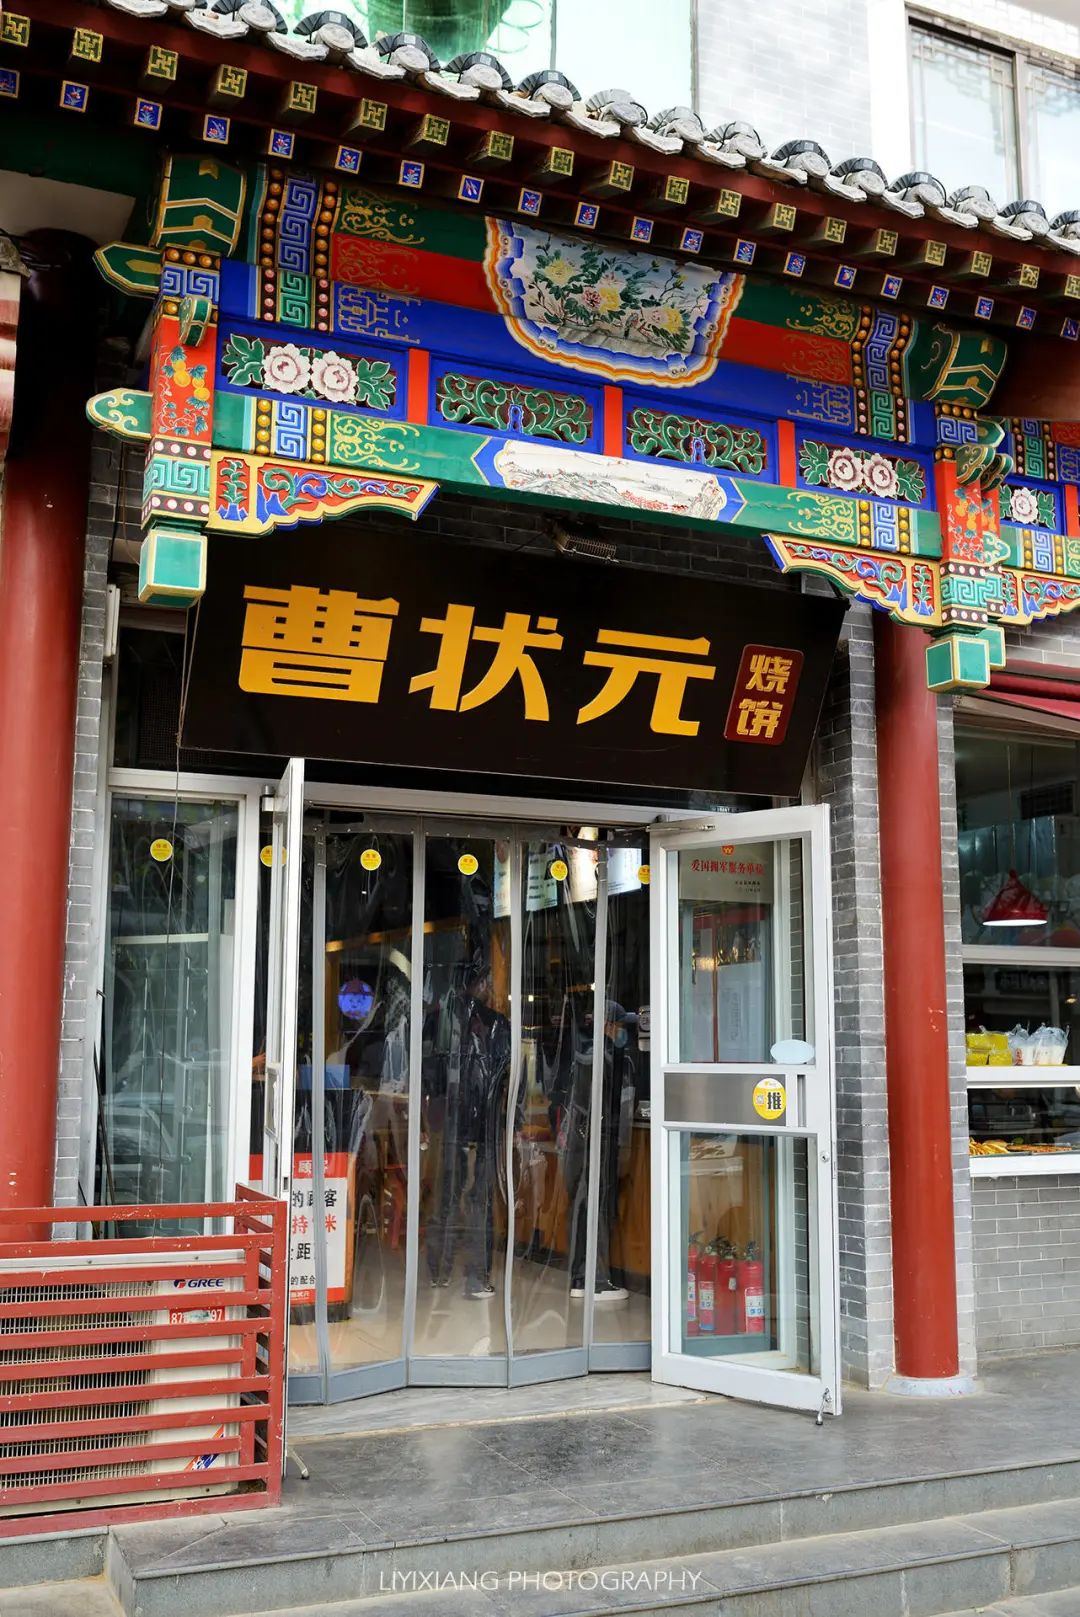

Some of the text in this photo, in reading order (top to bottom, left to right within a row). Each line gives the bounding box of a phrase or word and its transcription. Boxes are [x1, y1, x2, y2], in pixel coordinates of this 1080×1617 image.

[238, 583, 717, 737] 曹状元
[736, 654, 793, 738] 烧饼
[767, 1091, 782, 1110] 推
[292, 1214, 336, 1234] 持米
[188, 1278, 225, 1288] GREE
